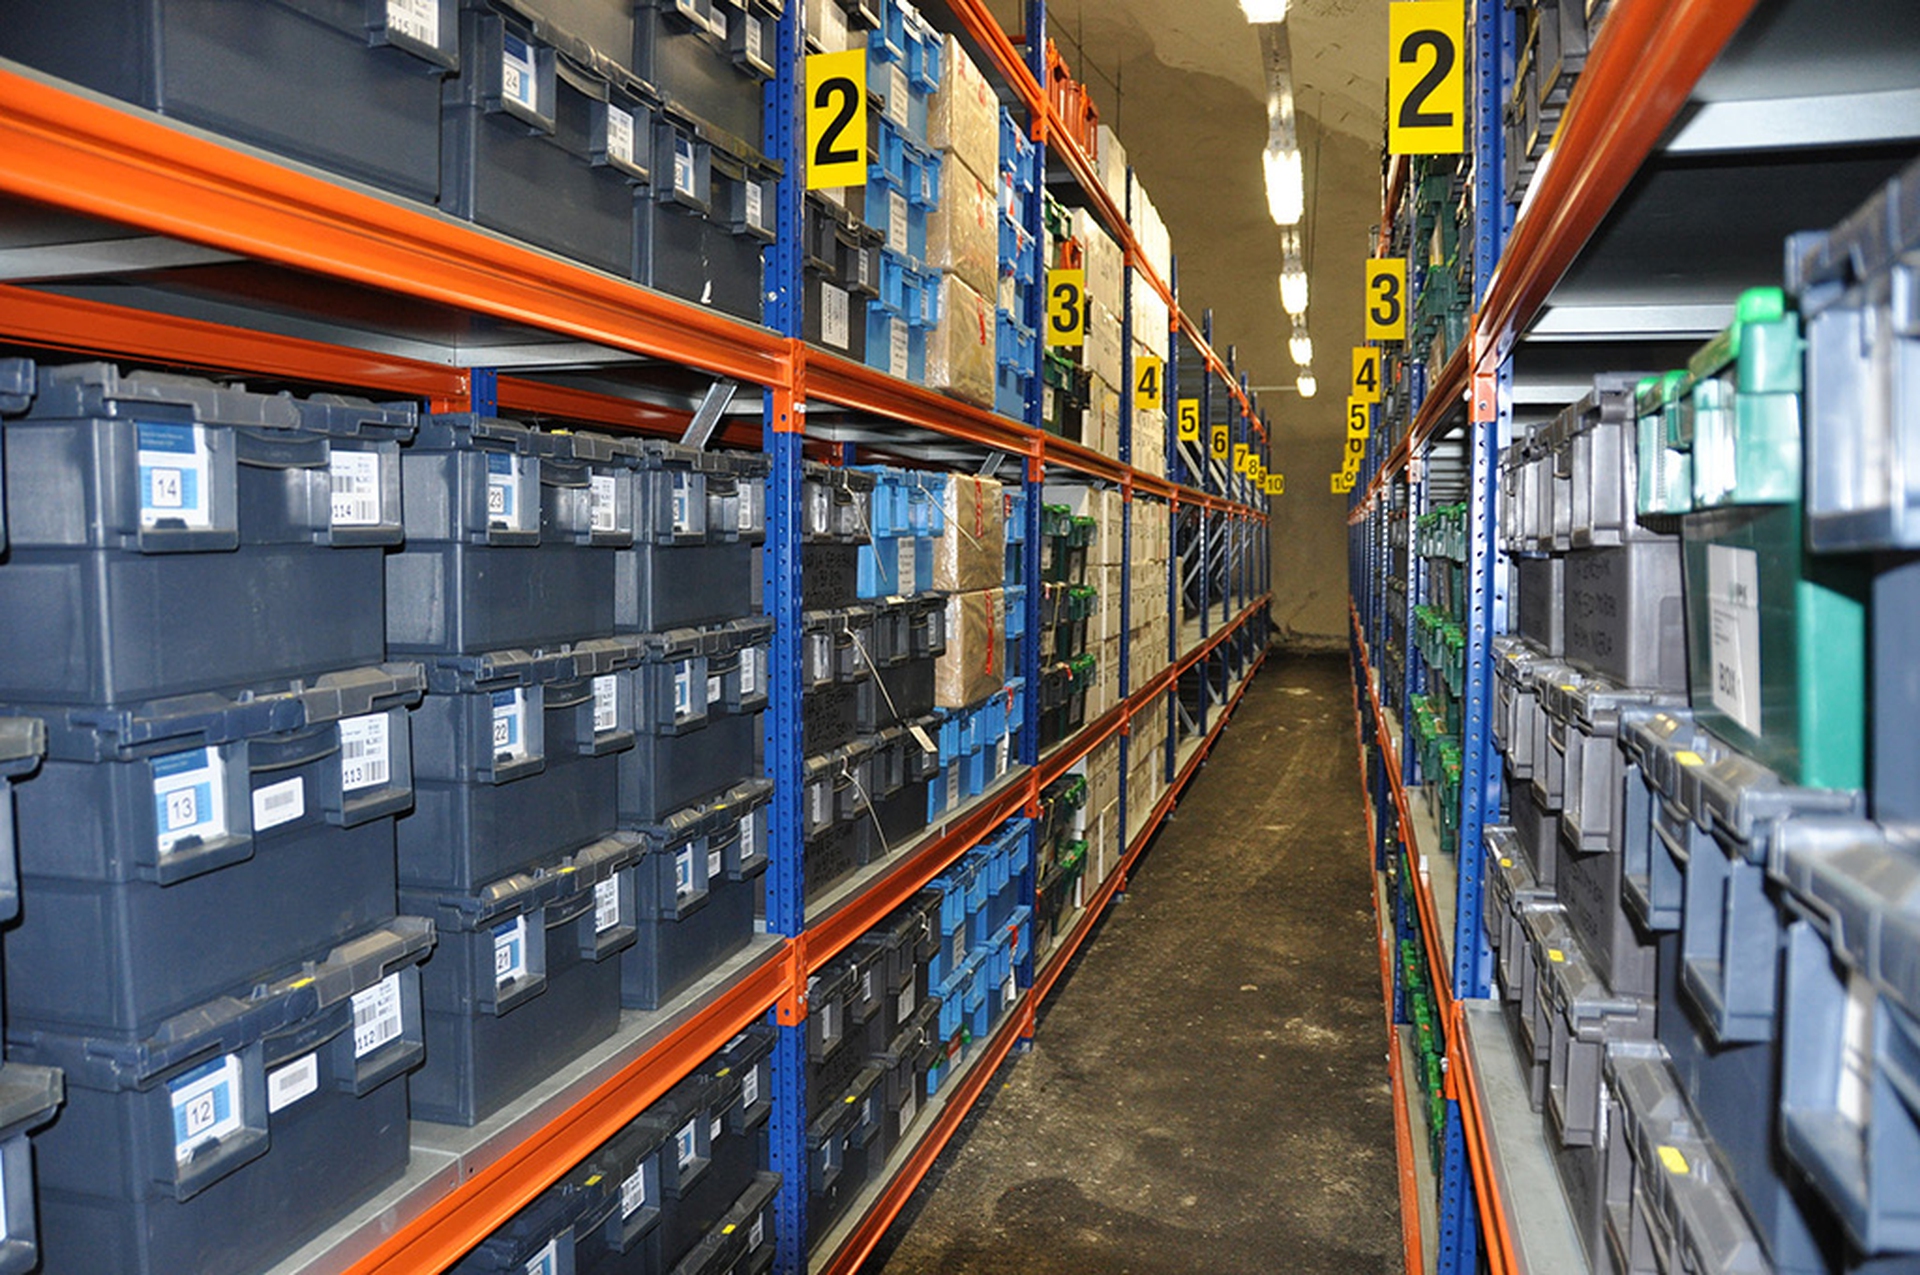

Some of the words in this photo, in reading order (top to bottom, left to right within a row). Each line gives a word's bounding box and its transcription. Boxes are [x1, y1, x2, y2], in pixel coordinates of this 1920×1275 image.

[506, 71, 517, 88] 24
[1399, 30, 1455, 128] 2
[815, 77, 859, 165] 2
[1052, 283, 1080, 332] 3
[1371, 274, 1400, 326] 3
[1138, 367, 1157, 399] 4
[1356, 358, 1377, 392] 4
[1181, 407, 1196, 433] 5
[1351, 404, 1366, 430] 5
[1213, 431, 1226, 453] 6
[1236, 449, 1246, 467] 7
[1248, 459, 1258, 475] 8
[1258, 470, 1267, 485] 9
[1268, 477, 1283, 491] 10
[158, 479, 177, 498] 14
[489, 490, 502, 508] 23
[333, 504, 351, 518] 114
[495, 723, 506, 742] 22
[344, 767, 362, 784] 113
[172, 796, 193, 821] 13
[357, 1030, 376, 1050] 112
[192, 1101, 211, 1126] 12
